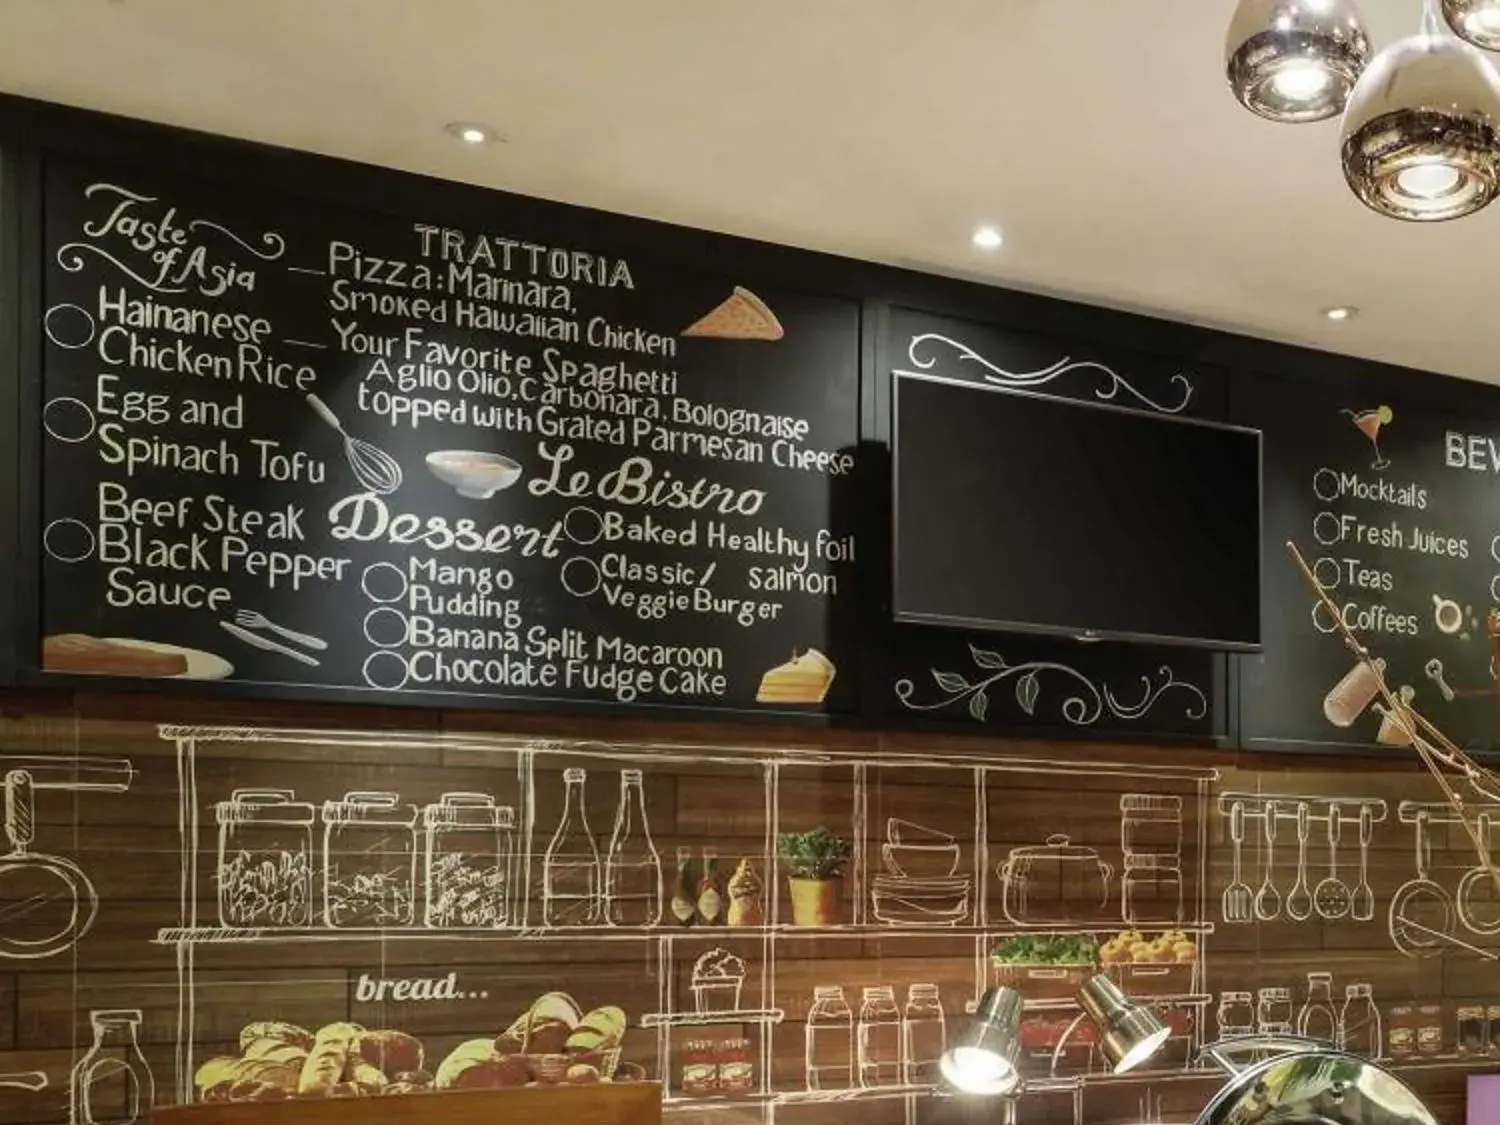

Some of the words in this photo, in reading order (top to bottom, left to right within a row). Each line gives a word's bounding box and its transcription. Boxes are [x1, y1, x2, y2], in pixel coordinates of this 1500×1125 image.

[83, 183, 188, 251] Taste
[152, 247, 188, 290] of
[171, 246, 255, 297] Asia
[328, 240, 444, 291] Pizza:
[413, 223, 635, 289] TRATTORIA
[99, 286, 273, 345] Hainanese
[329, 279, 447, 323] Smoked
[455, 299, 579, 343] Hawaiian
[587, 316, 677, 357] Chicken
[99, 326, 232, 382] Chicken
[238, 344, 317, 390] Rice
[331, 317, 399, 357] Your
[405, 327, 532, 377] Favorite
[541, 347, 677, 395] Spaghetti
[97, 373, 171, 424] Egg
[180, 396, 244, 429] and
[357, 381, 467, 428] topped
[472, 404, 533, 433] with
[536, 405, 625, 445] Grated
[633, 417, 764, 462] Parmesan
[771, 440, 855, 475] Cheese
[365, 358, 452, 392] Aglio
[672, 397, 810, 441] Bolognaise
[99, 422, 239, 477] Spinach
[251, 440, 326, 484] Tofu
[527, 441, 593, 498] Le
[598, 456, 768, 516] Bistro
[99, 482, 192, 526] Beef
[204, 494, 304, 541] Steak
[1339, 471, 1428, 510] Mocktails
[328, 491, 565, 558] Dessert
[603, 511, 697, 547] Baked
[707, 520, 810, 573] Healthy
[815, 529, 855, 562] foil
[1340, 515, 1404, 549] Fresh
[1407, 526, 1470, 560] Juices
[99, 522, 211, 572] Black
[221, 536, 352, 590] Pepper
[408, 555, 514, 596] Mango
[748, 565, 838, 595] salmon
[1343, 558, 1394, 593] Teas
[106, 568, 232, 612] Sauce
[408, 584, 522, 629] Pudding
[602, 582, 689, 619] Veggie
[693, 588, 783, 626] Burger
[408, 615, 519, 652] Banana
[524, 625, 589, 660] Split
[597, 636, 723, 671] Macaroon
[1341, 602, 1419, 636] Coffees
[408, 651, 558, 687] Chocolate
[565, 659, 654, 702] Fudge
[659, 667, 728, 696] Cake
